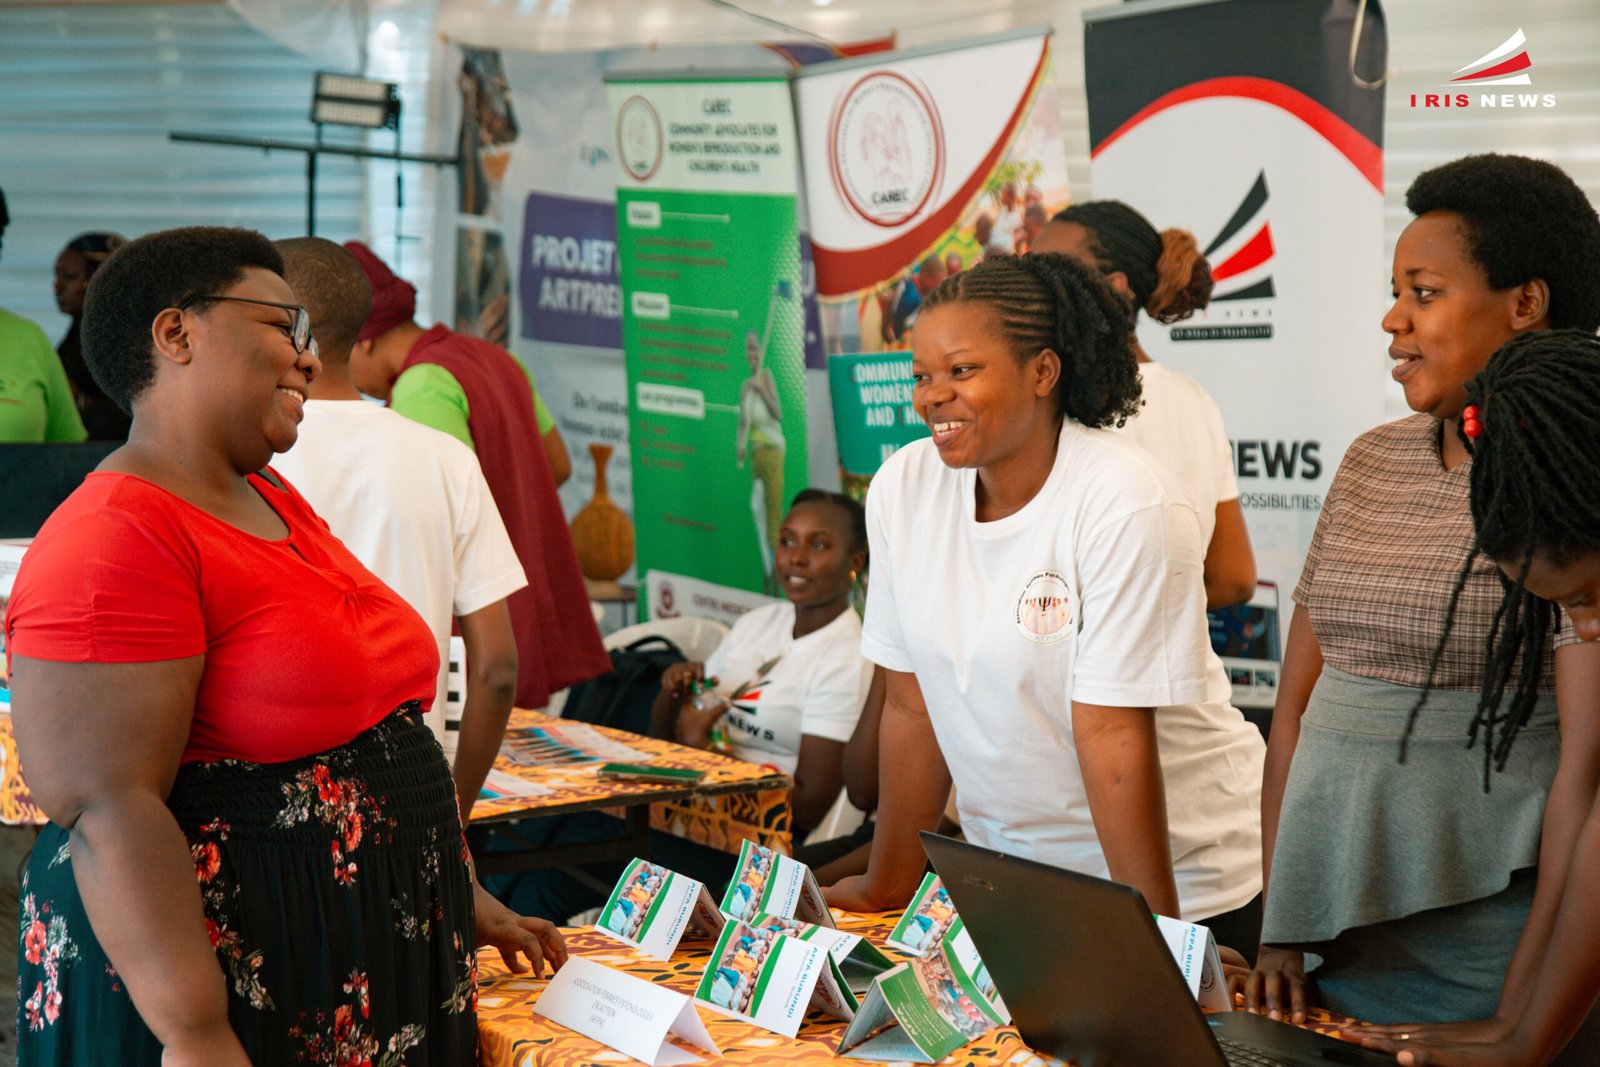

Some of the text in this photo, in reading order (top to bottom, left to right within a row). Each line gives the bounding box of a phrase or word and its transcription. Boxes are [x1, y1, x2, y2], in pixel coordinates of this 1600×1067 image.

[871, 187, 909, 205] CABEC
[532, 233, 616, 276] PROJET
[866, 405, 895, 427] AND
[1228, 440, 1323, 480] EWS
[1239, 492, 1322, 511] OSSIBILITIES
[727, 712, 775, 741] NEWS
[1187, 925, 1197, 951] AFPA
[786, 946, 818, 1019] AFPA BURUNDI
